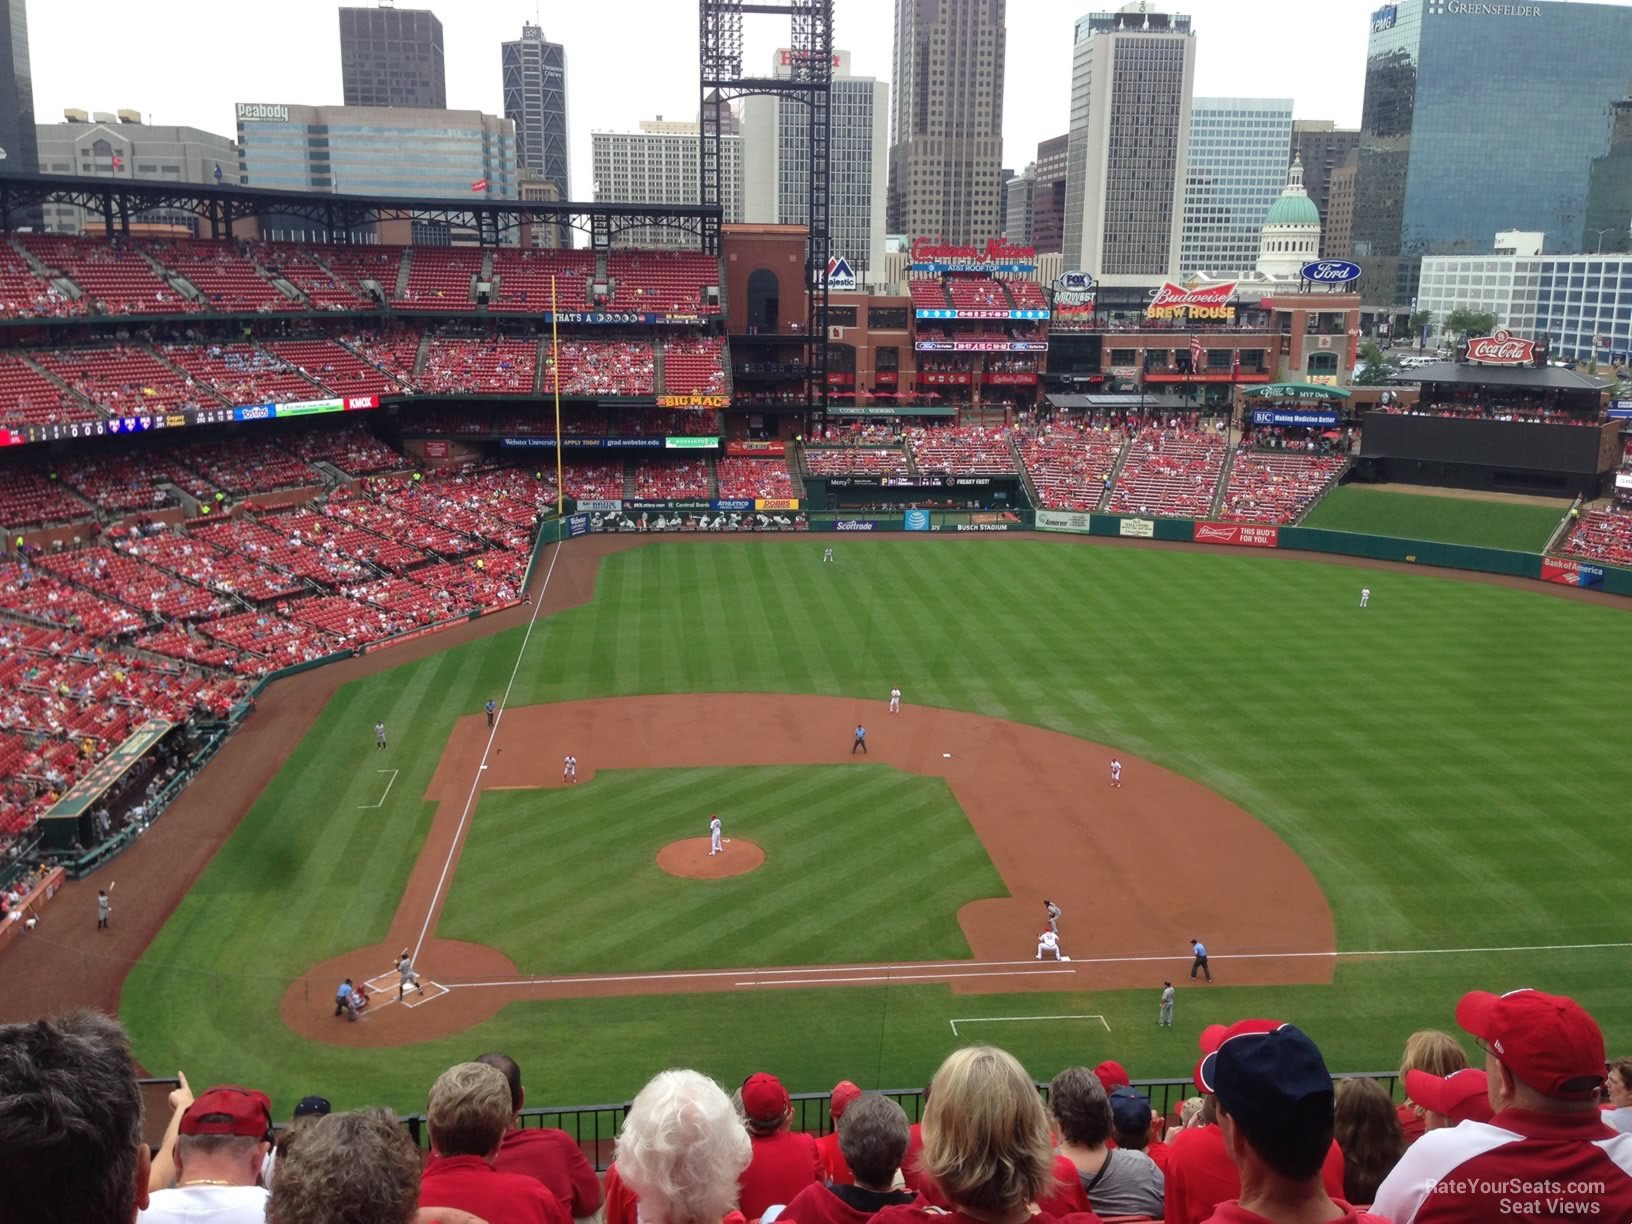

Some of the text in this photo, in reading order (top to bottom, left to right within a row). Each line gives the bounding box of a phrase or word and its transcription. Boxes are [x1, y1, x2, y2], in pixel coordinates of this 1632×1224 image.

[1370, 15, 1392, 33] KPMG
[238, 103, 288, 121] Peabody
[1313, 263, 1350, 279] Ford
[1067, 275, 1085, 283] FOX
[1055, 292, 1096, 302] MIDWEST
[585, 313, 593, 322] A
[1146, 306, 1236, 319] BREW HOUSE
[1475, 341, 1526, 358] Coca-Cola
[349, 398, 372, 408] KMOX
[665, 397, 722, 406] BIG MAC
[1256, 414, 1271, 422] BJC
[504, 438, 526, 446] Webster
[528, 438, 557, 447] University
[607, 438, 660, 448] grad.webster.edu
[836, 521, 873, 531] Scottrade
[1256, 529, 1276, 537] BUD'S
[1254, 536, 1269, 544] YOU.
[1544, 558, 1563, 568] Bank
[1571, 563, 1603, 576] America
